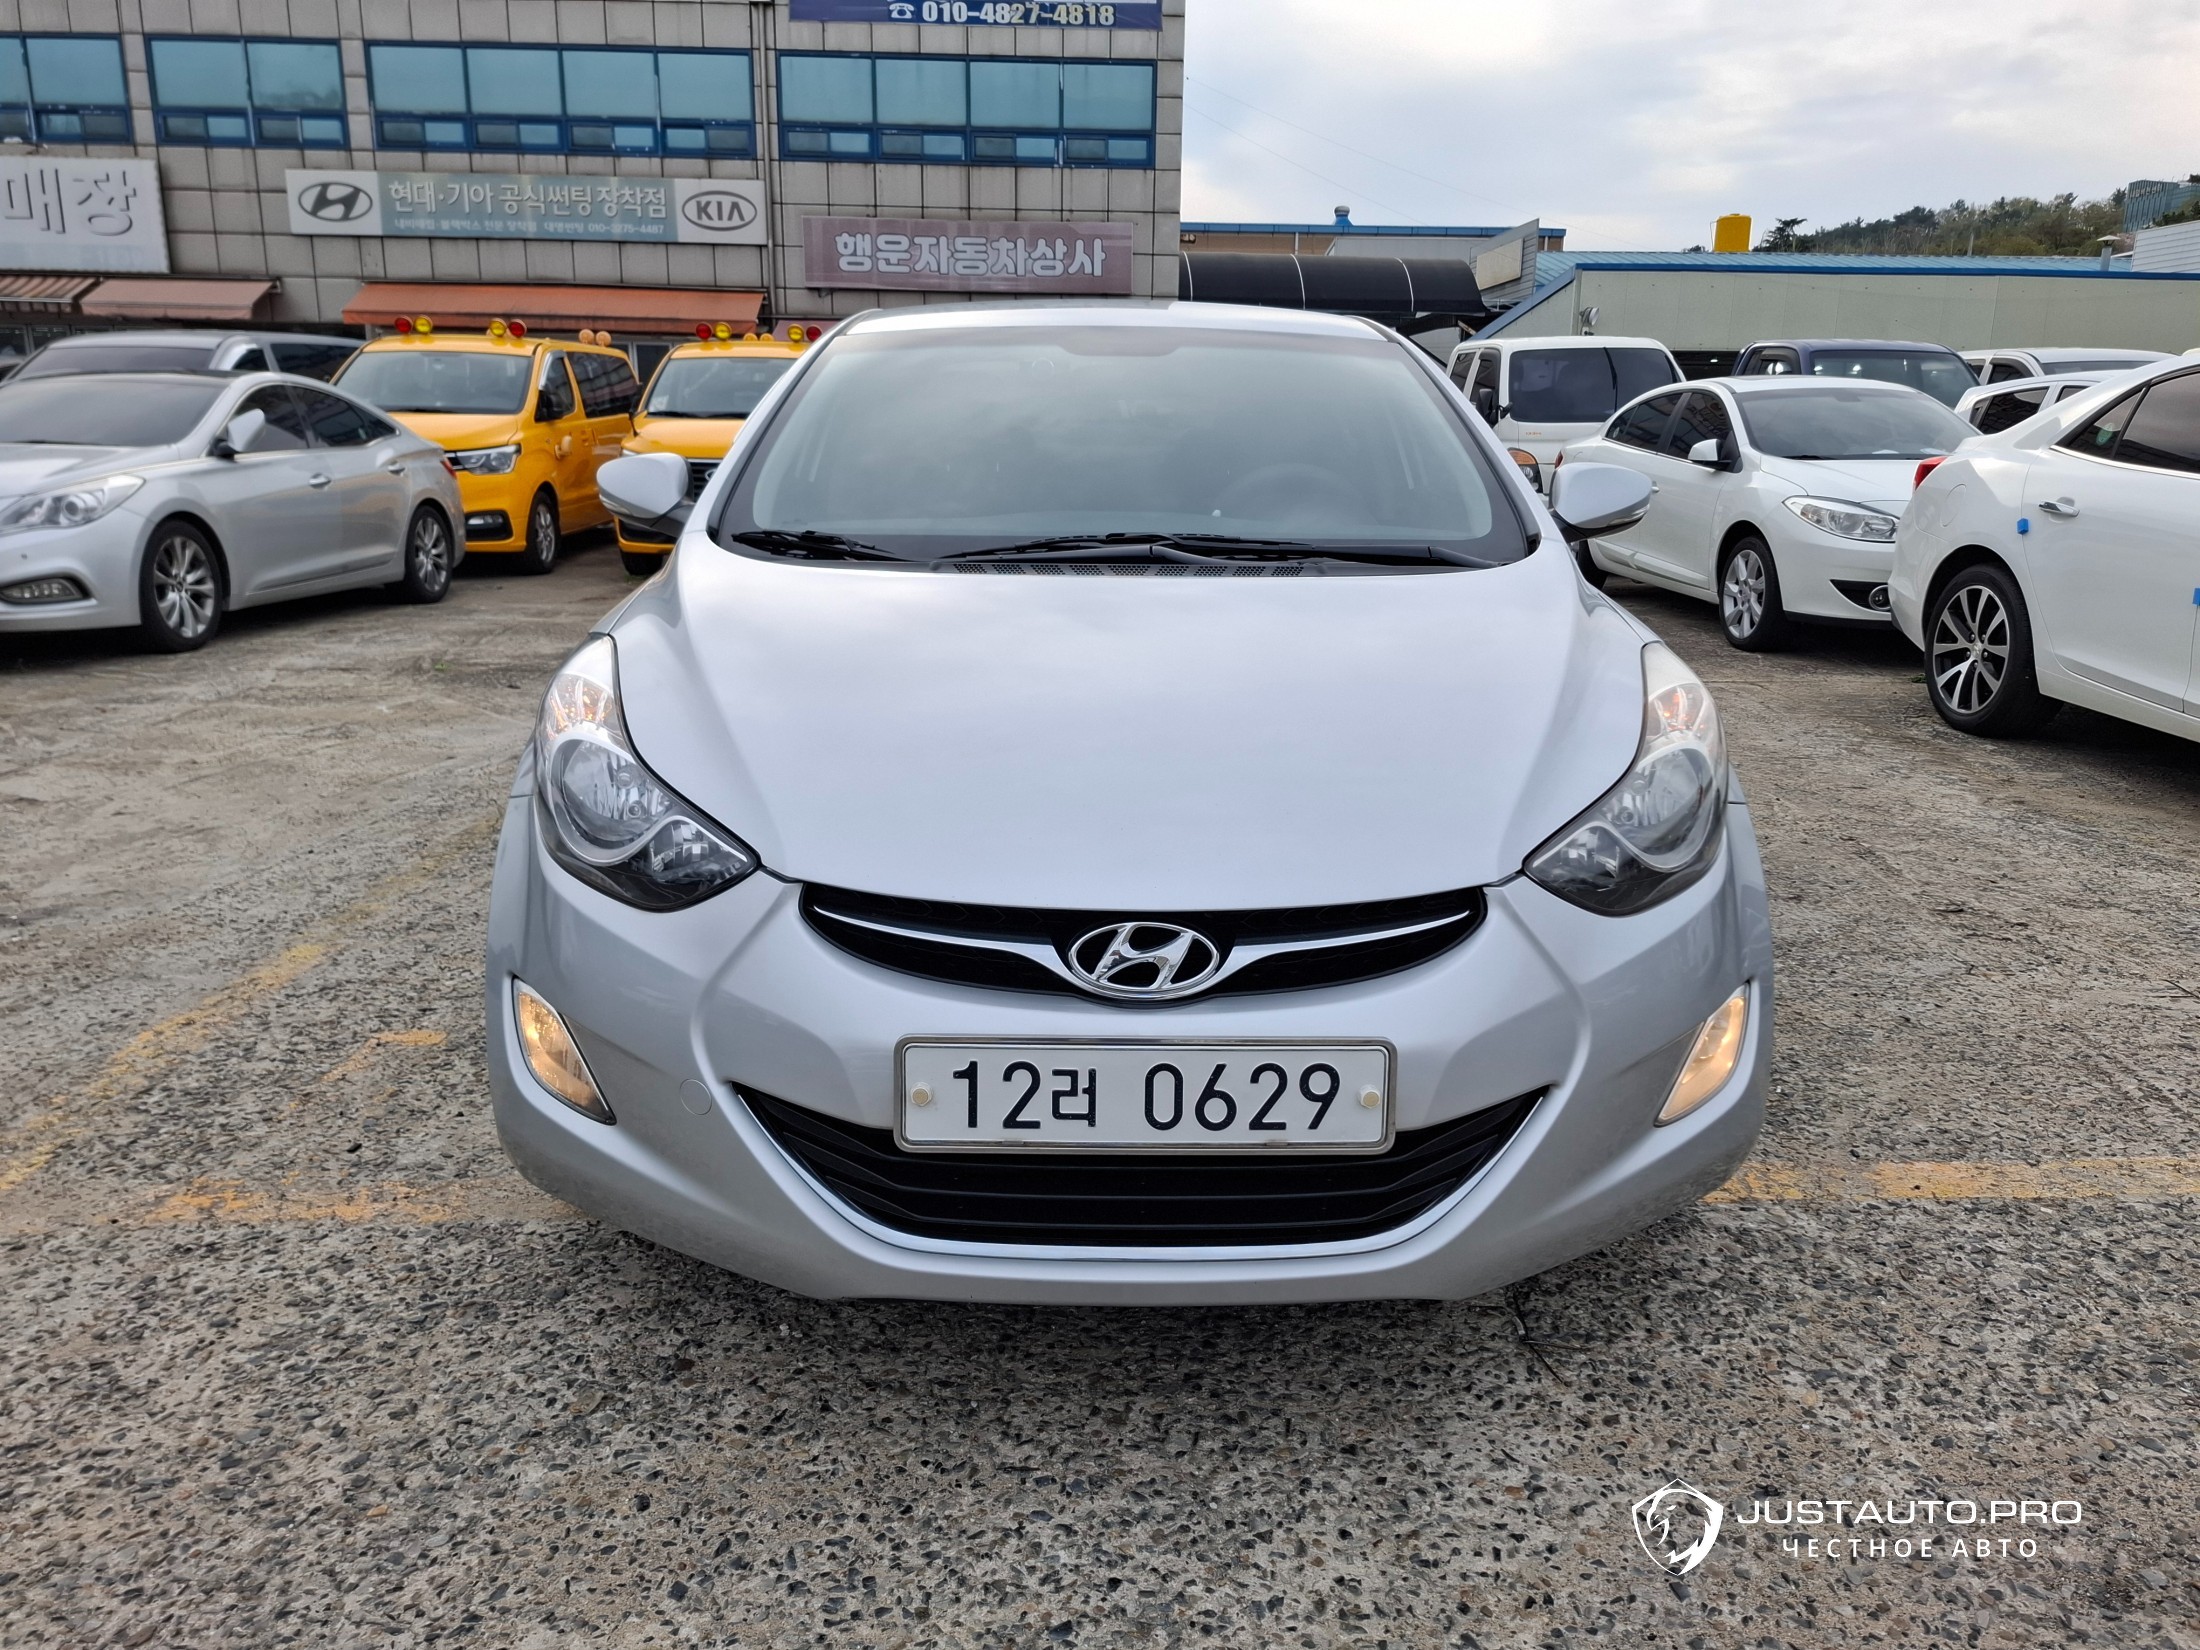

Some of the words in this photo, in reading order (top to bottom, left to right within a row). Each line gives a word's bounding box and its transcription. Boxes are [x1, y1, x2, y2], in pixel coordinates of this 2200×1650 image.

[922, 1, 1115, 26] 010-4827-4818
[597, 185, 668, 218] 장착점
[696, 200, 746, 222] KIA
[834, 231, 1107, 277] 행운자동차상사
[952, 1060, 1097, 1129] 12러
[1144, 1062, 1341, 1132] 0629
